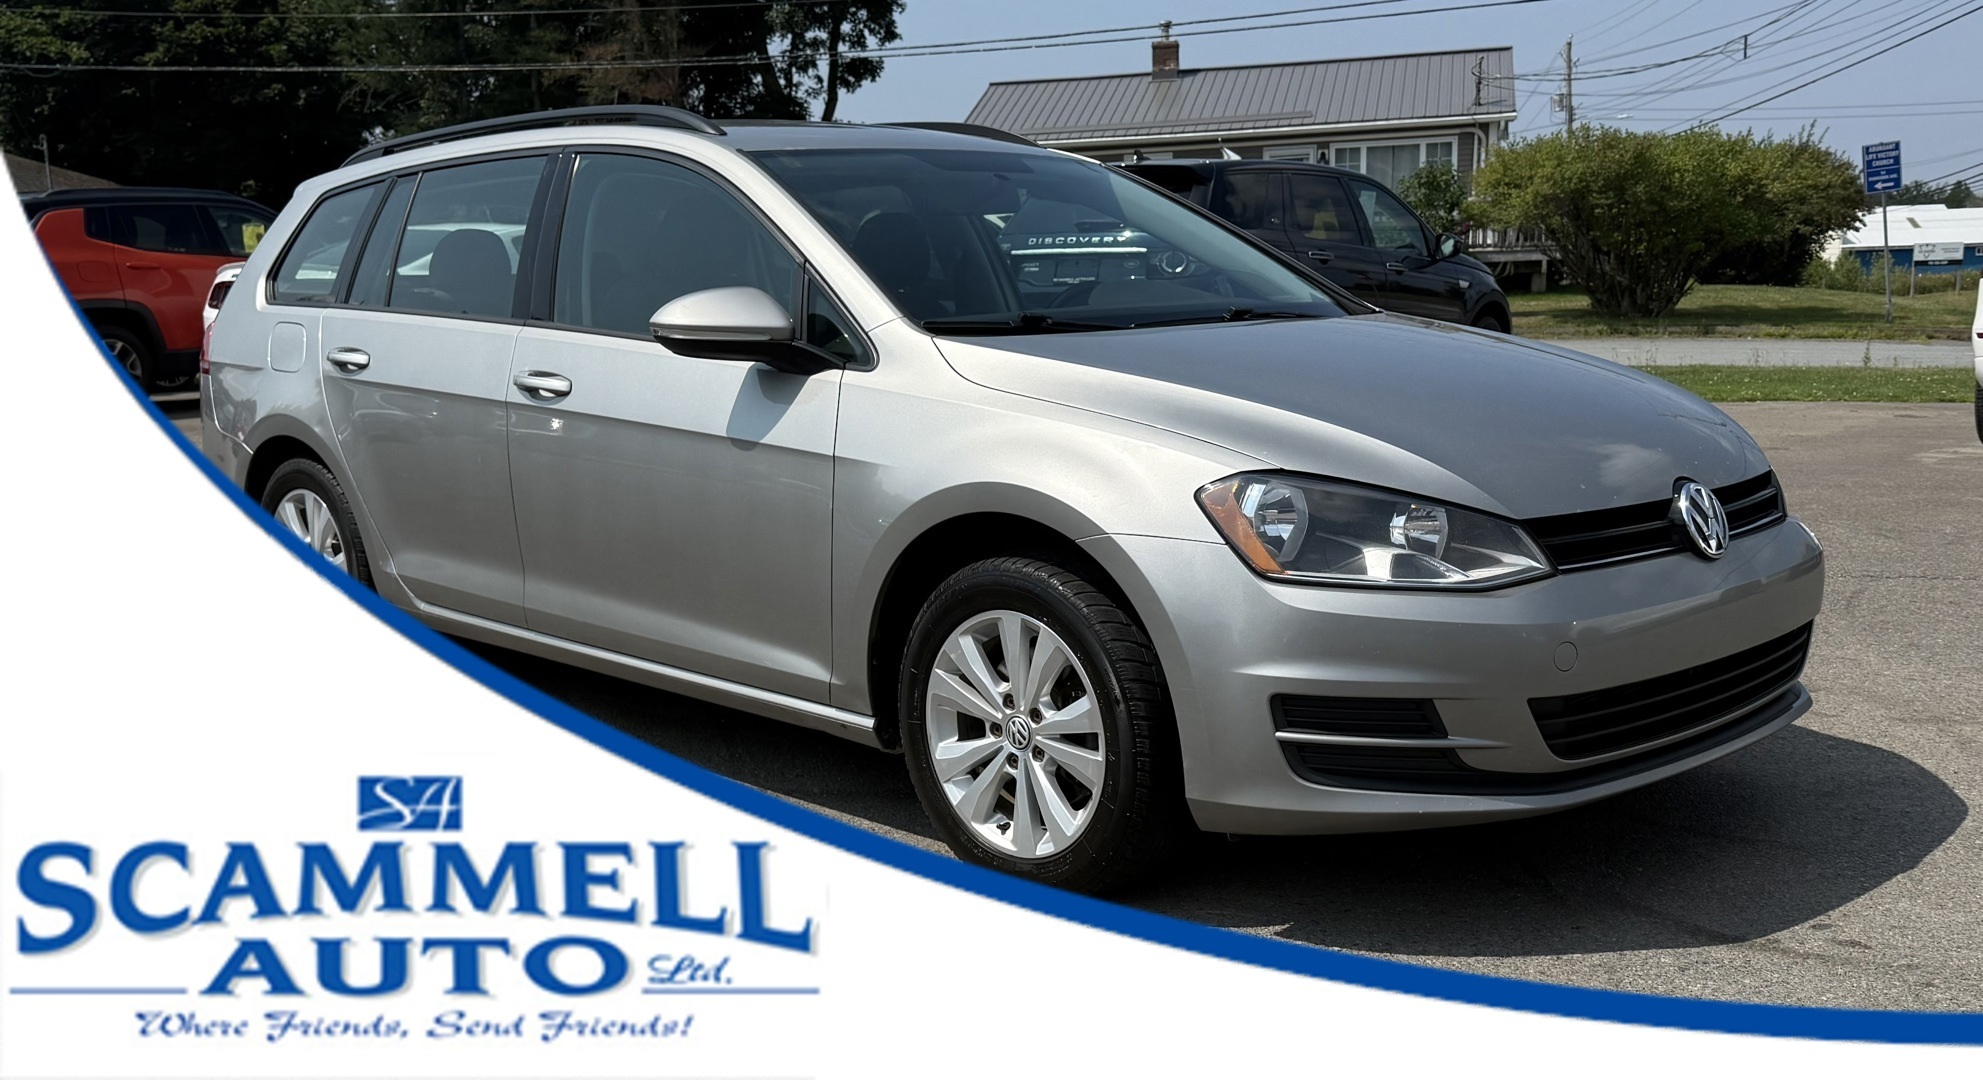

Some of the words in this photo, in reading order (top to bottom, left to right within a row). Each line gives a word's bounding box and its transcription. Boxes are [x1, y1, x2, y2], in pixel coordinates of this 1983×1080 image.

[1878, 150, 1899, 158] VICTORY
[1872, 158, 1894, 166] CHURCH
[1028, 236, 1127, 246] DISCOVERY
